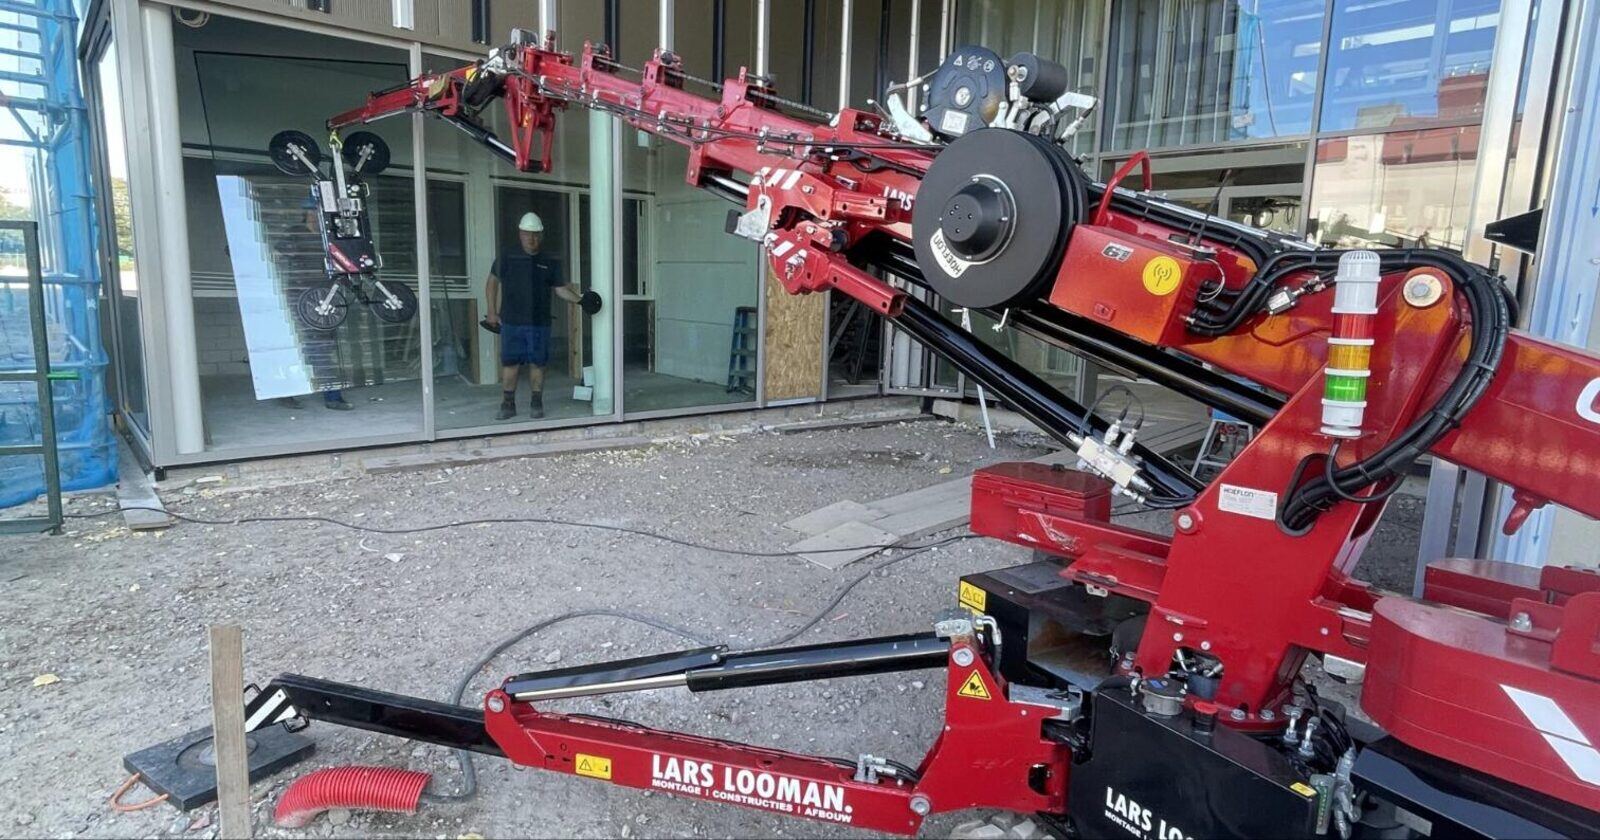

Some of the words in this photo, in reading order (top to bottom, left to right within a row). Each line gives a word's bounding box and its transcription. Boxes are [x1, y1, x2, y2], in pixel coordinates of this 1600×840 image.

[652, 779, 702, 795] MONTAGE
[712, 790, 794, 813] CONSTRUCTIES
[804, 807, 852, 823] AFBOUW
[653, 754, 714, 788] LARS
[724, 767, 853, 813] LOOMAN.
[1104, 809, 1141, 839] MONTAGE
[1105, 786, 1152, 832] LARS
